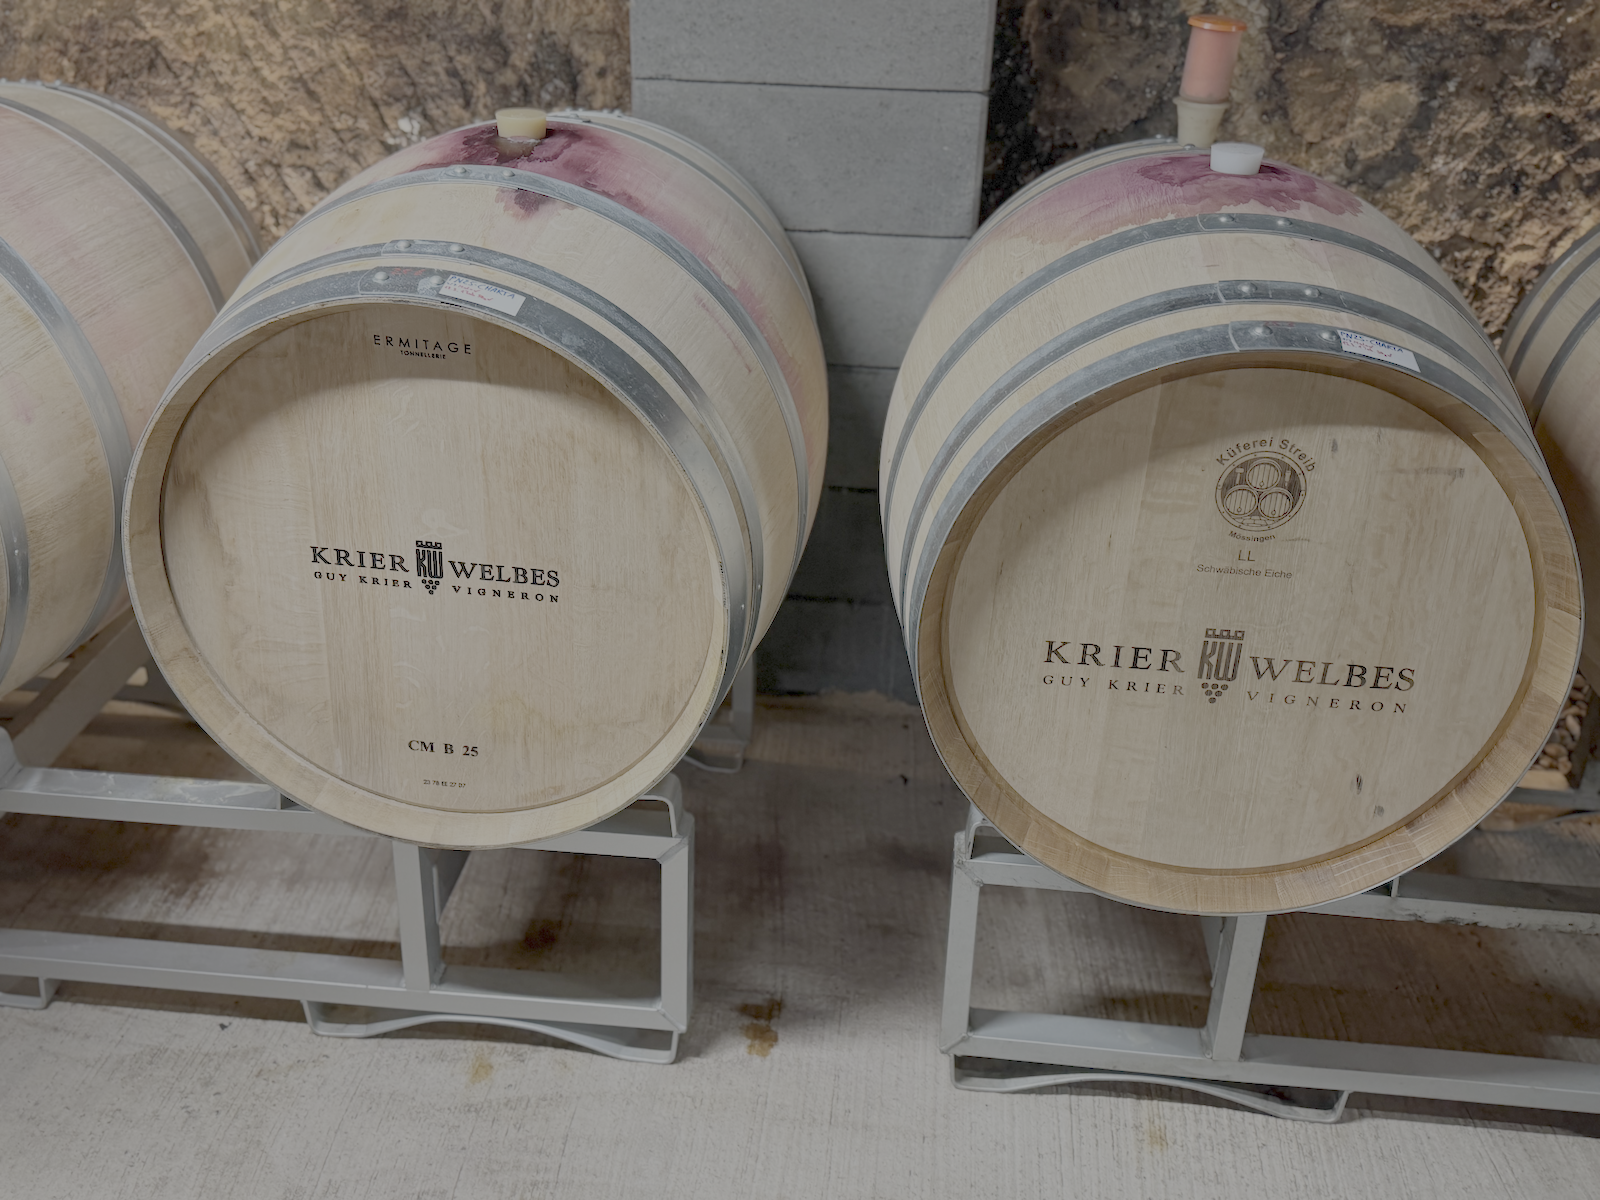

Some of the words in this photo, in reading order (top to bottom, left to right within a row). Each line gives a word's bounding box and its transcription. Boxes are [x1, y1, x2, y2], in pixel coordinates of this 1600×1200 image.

[373, 333, 472, 355] ERMITAGE
[400, 350, 446, 360] TONNELLERIE
[1216, 436, 1274, 466] Küferei
[1279, 439, 1317, 473] Streib
[1228, 530, 1276, 543] Mössingen
[310, 545, 410, 573] KRIER
[448, 560, 561, 588] WELBES
[1237, 549, 1256, 562] LL
[1196, 564, 1262, 577] Schwäbische
[1264, 568, 1293, 579] Eiche
[313, 571, 348, 582] GUY
[359, 575, 412, 589] KRIER
[451, 585, 560, 603] VIGNERON
[1043, 640, 1186, 673] KRIER
[1249, 655, 1416, 692] WELBES
[1042, 674, 1091, 688] GUY
[1107, 678, 1186, 696] KRIER
[1246, 690, 1408, 714] VIGNERON
[408, 739, 436, 753] CM
[443, 742, 455, 755] B
[462, 745, 479, 757] 25
